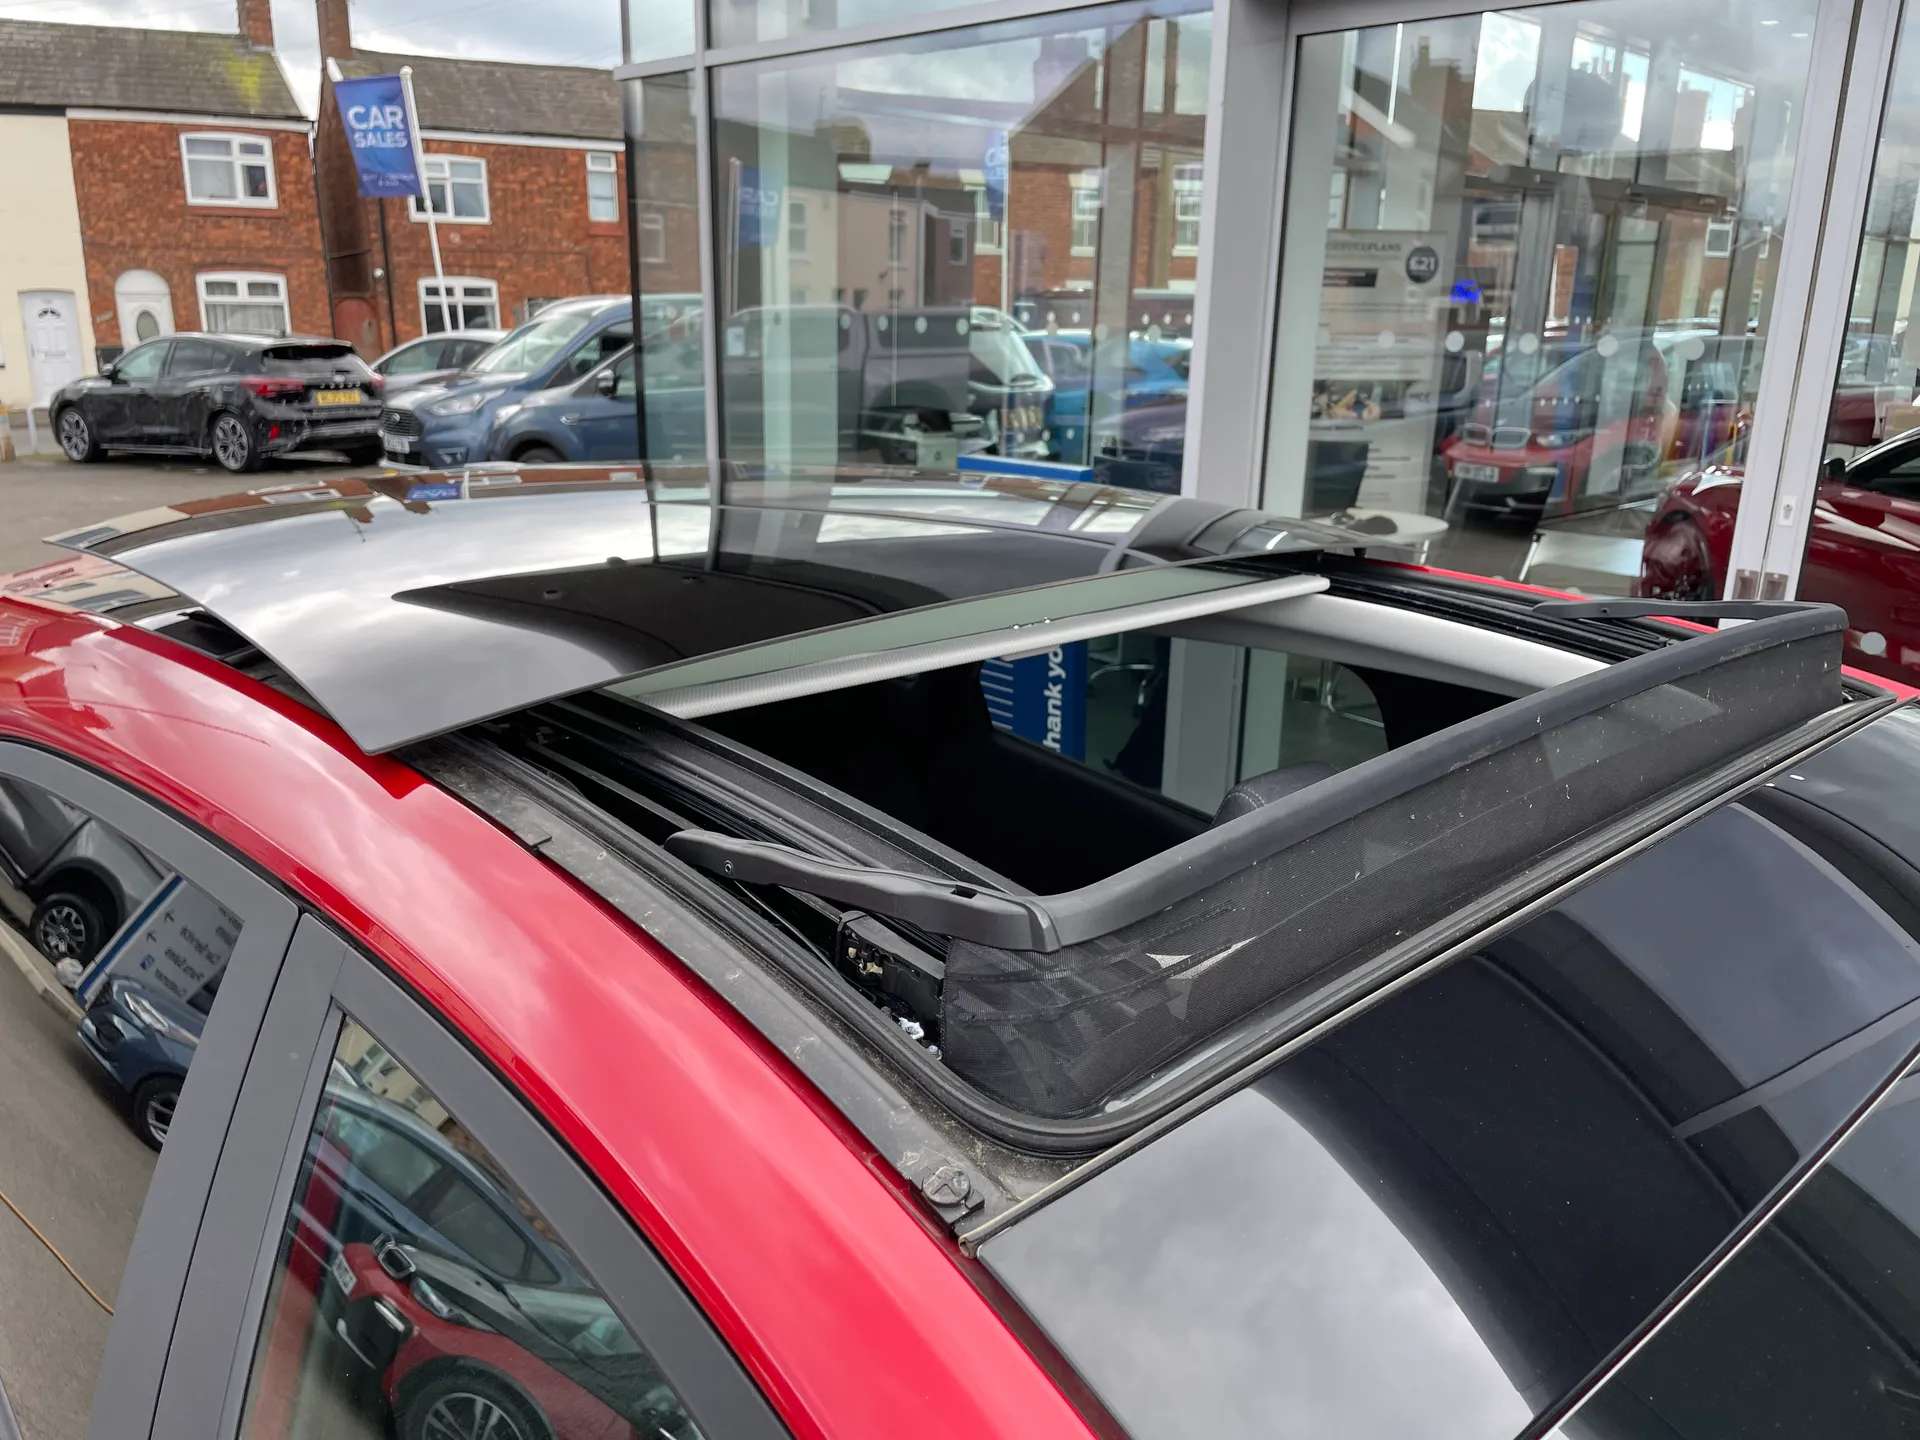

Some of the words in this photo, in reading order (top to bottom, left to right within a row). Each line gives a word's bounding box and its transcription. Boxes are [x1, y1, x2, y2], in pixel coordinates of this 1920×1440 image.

[347, 104, 405, 130] CAR
[353, 130, 408, 149] SALES
[1042, 681, 1063, 753] hank
